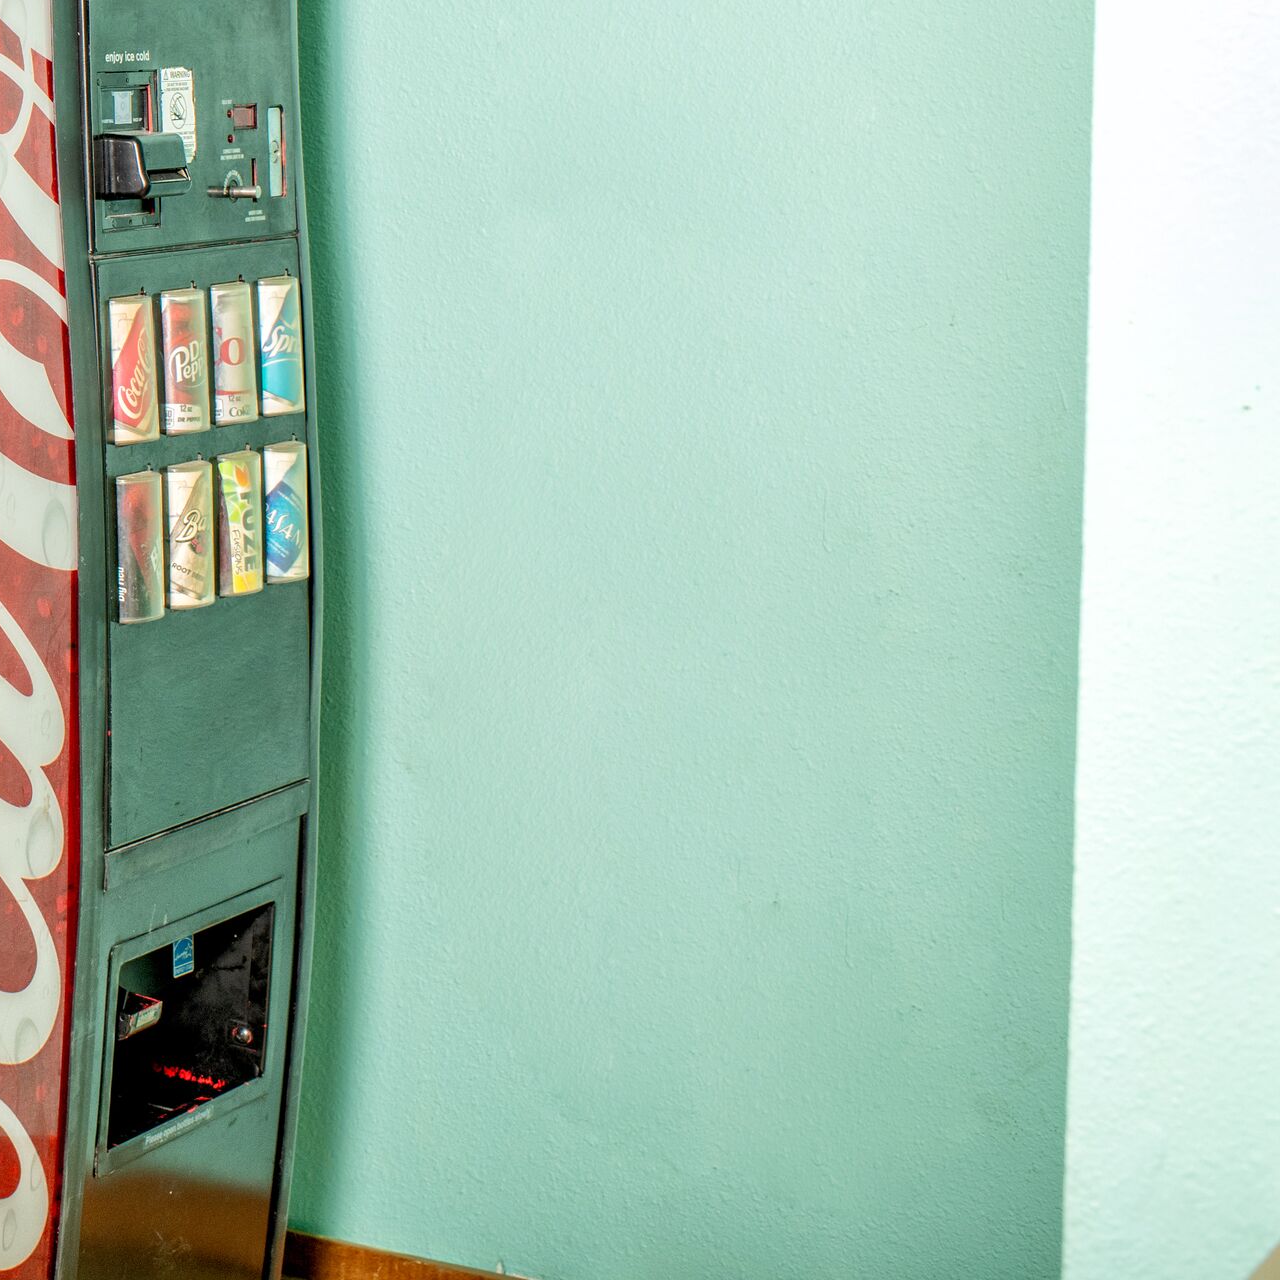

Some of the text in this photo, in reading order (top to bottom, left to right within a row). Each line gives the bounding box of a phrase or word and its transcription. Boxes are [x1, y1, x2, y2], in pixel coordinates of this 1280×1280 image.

[104, 50, 150, 64] enjoy ice cold
[239, 490, 257, 572] FUZE
[171, 562, 192, 576] ROOT
